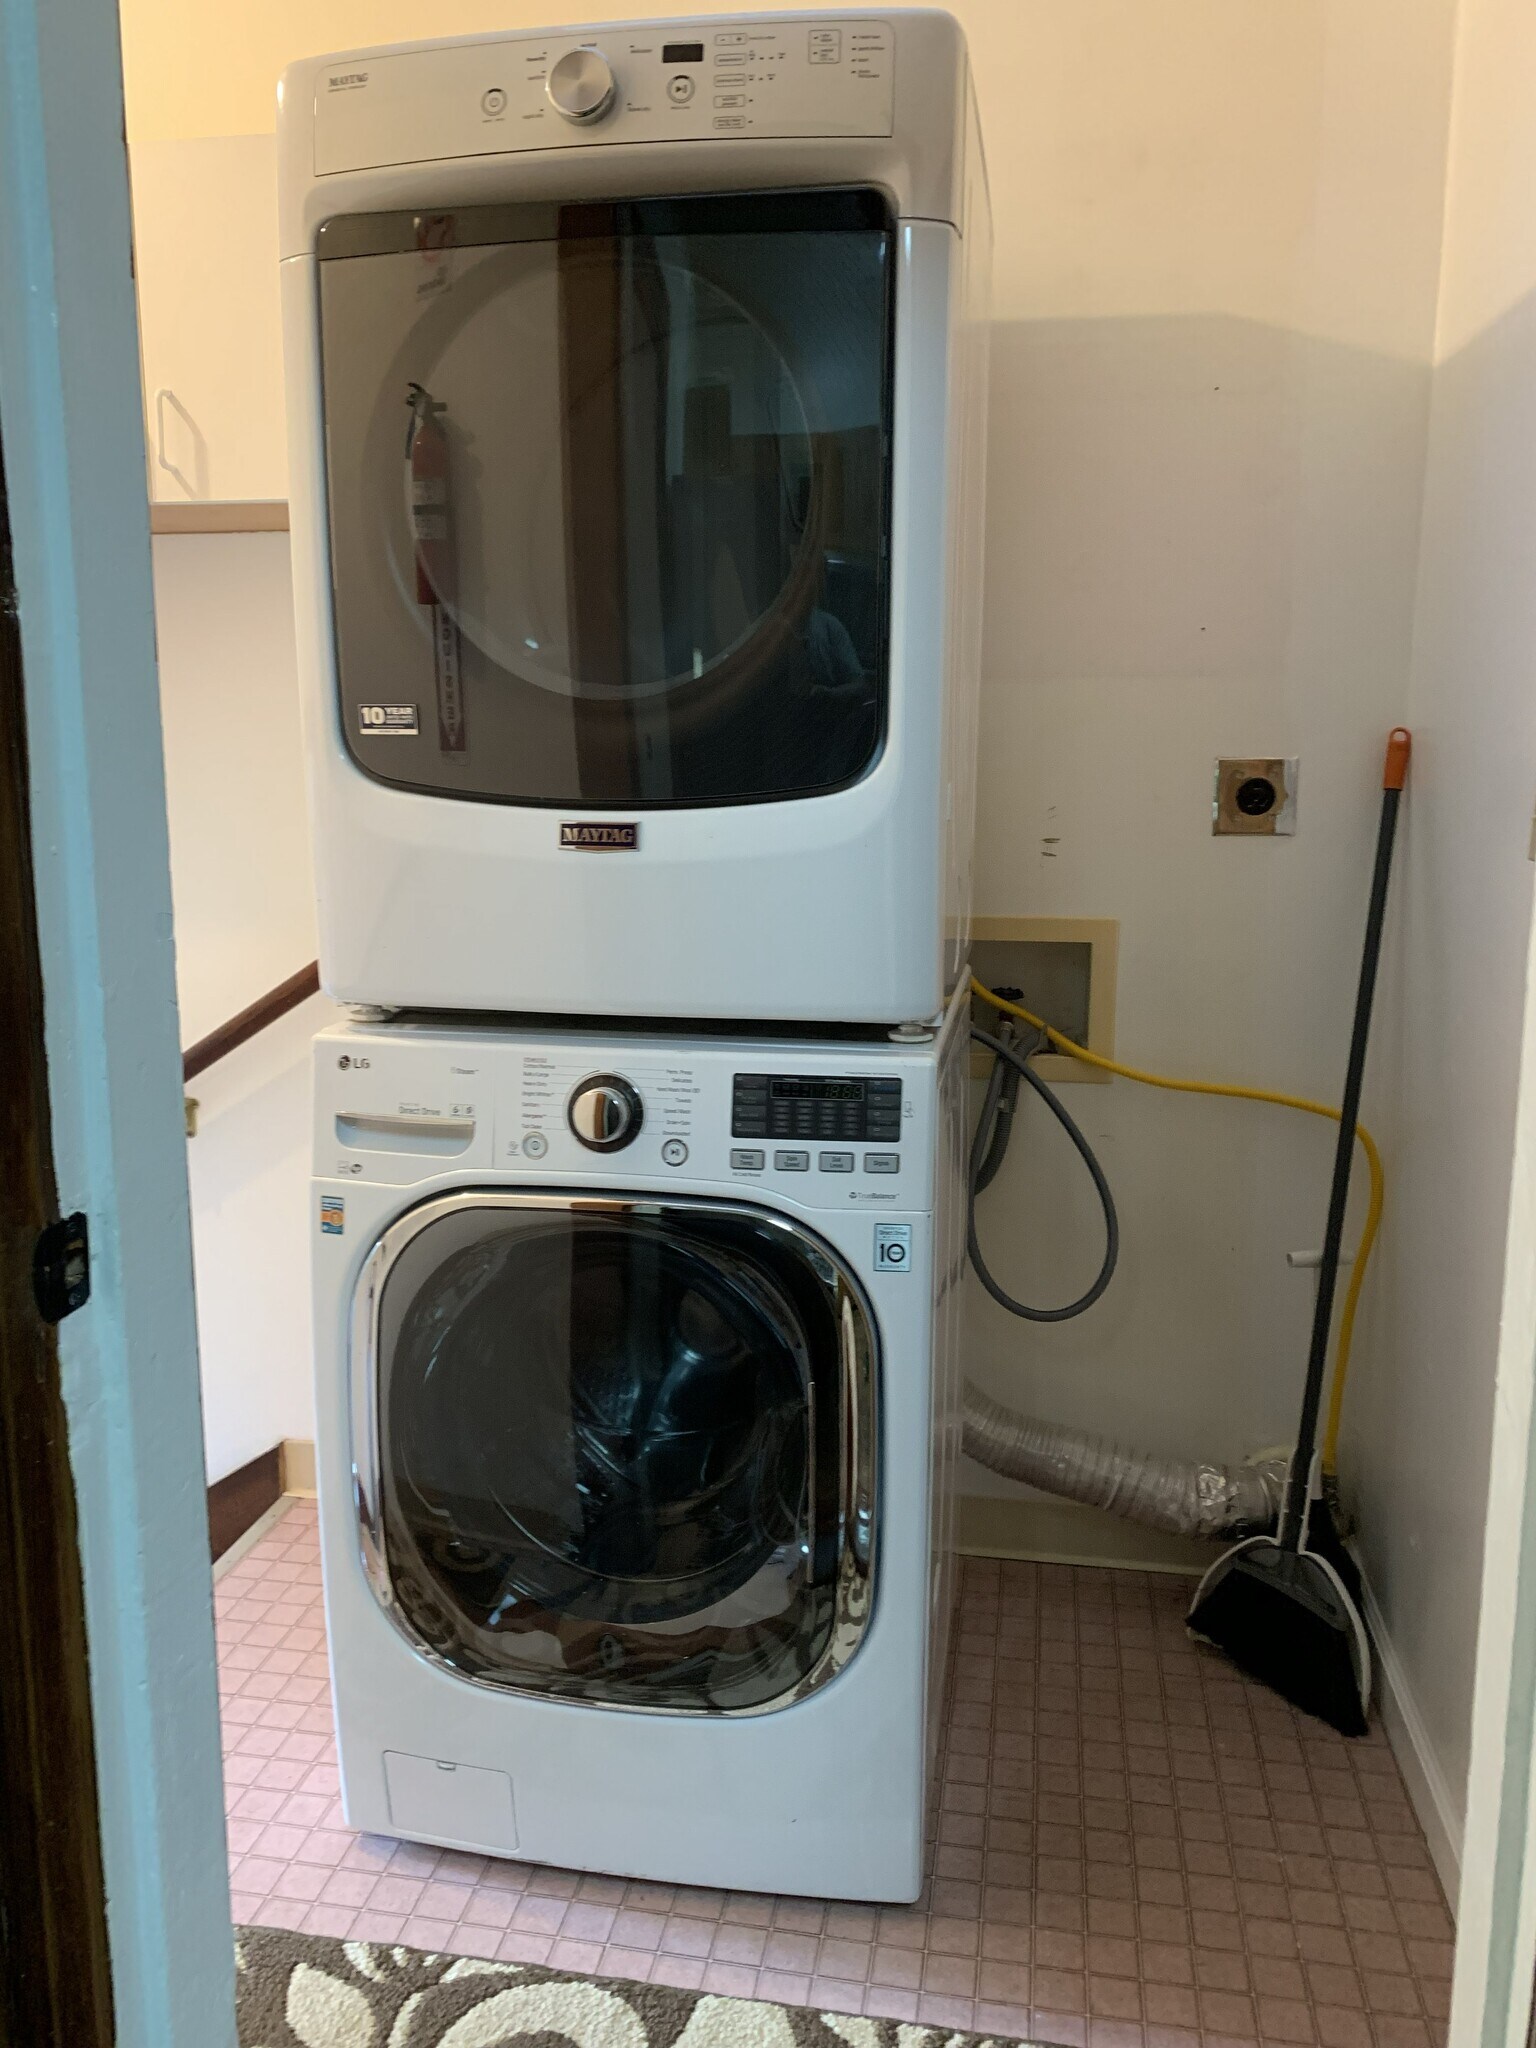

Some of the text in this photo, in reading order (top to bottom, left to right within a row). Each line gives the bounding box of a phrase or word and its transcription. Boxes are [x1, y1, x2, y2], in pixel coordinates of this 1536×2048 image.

[328, 73, 368, 87] MAYTAG
[361, 707, 386, 724] 10
[385, 707, 413, 715] YEAR
[562, 828, 634, 842] MAYTAG
[353, 1058, 371, 1069] LG
[880, 1243, 905, 1263] 10
